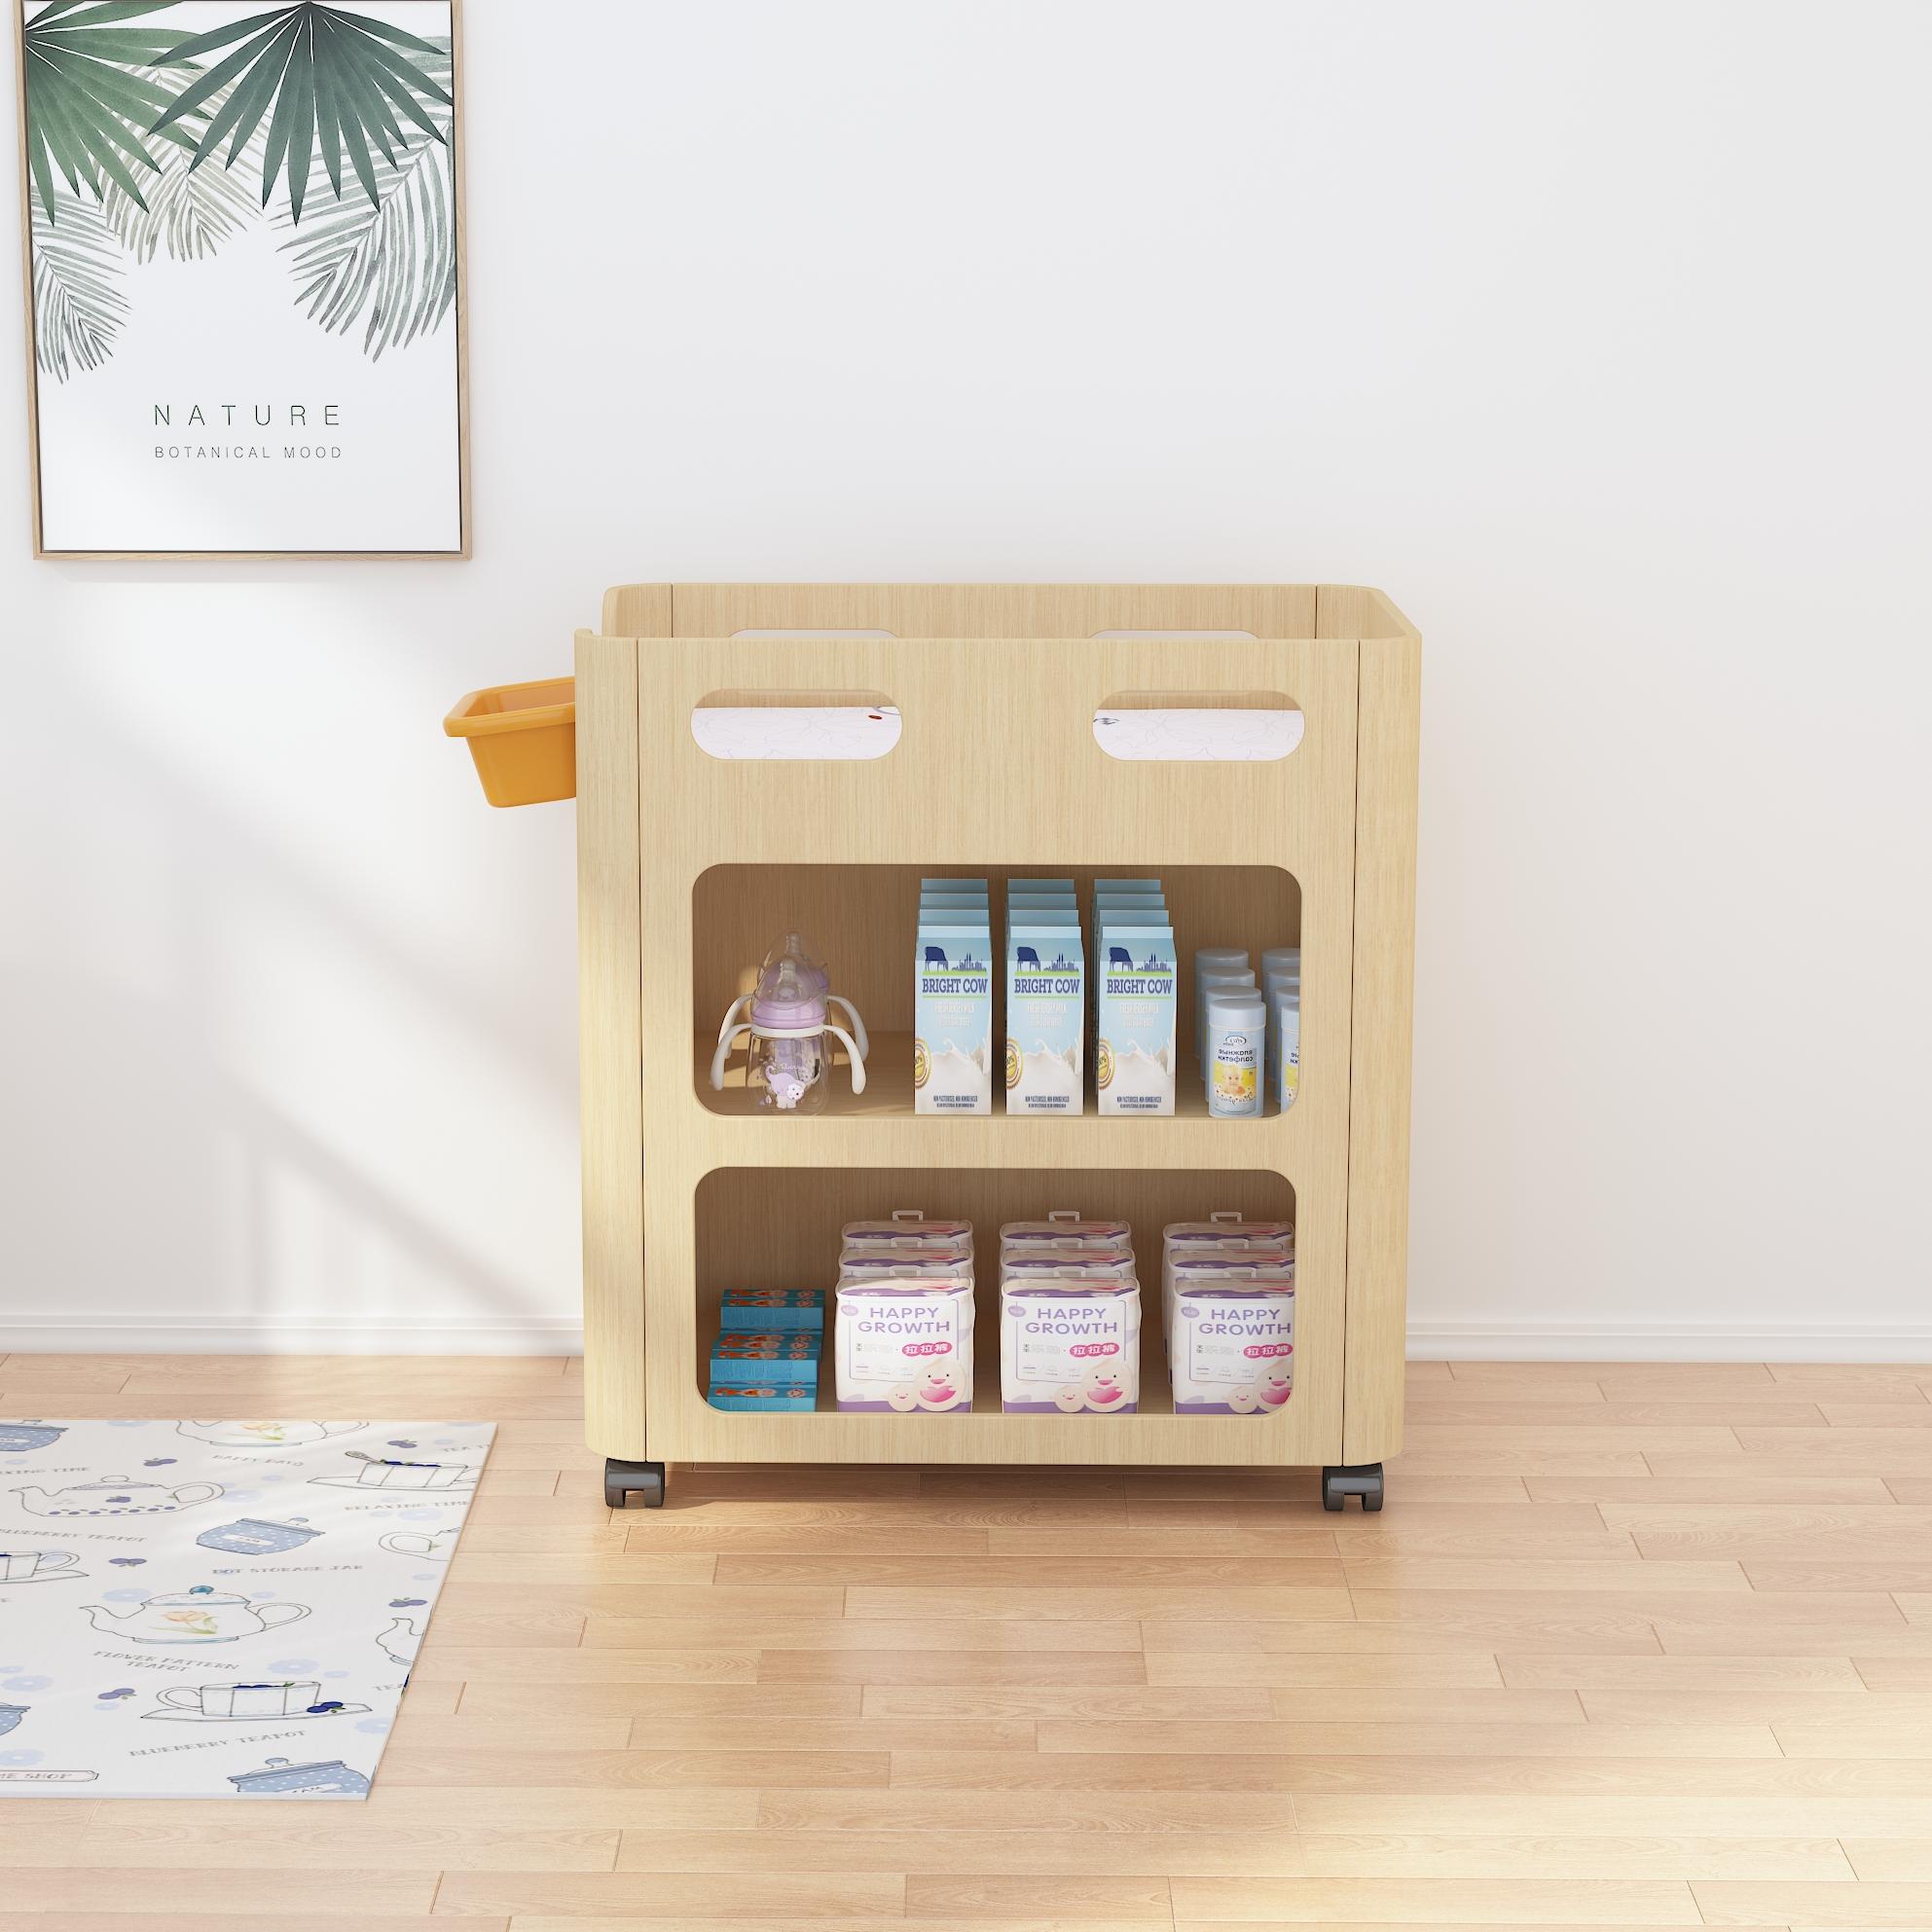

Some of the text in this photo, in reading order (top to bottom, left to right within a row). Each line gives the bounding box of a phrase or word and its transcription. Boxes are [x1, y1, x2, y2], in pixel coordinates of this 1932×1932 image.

[154, 404, 340, 426] NATURE
[155, 446, 342, 458] BOTANICAL MOOD
[922, 978, 988, 994] BRIGHT COW
[1014, 978, 1080, 994] BRIGHT COW
[1107, 979, 1173, 995] BRIGHT COW
[870, 1307, 939, 1319] HAPPY
[1038, 1308, 1107, 1319] HAPPY
[1211, 1309, 1280, 1321] HAPPY
[857, 1322, 950, 1333] GROWTH
[1025, 1322, 1117, 1334] GROWTH
[1199, 1323, 1292, 1335] GROWTH
[905, 1344, 949, 1354] 拉拉裤
[1073, 1345, 1116, 1355] 拉拉裤
[1247, 1346, 1290, 1356] 拉拉裤
[129, 1730, 308, 1756] BLUEBERRY TEAPOT
